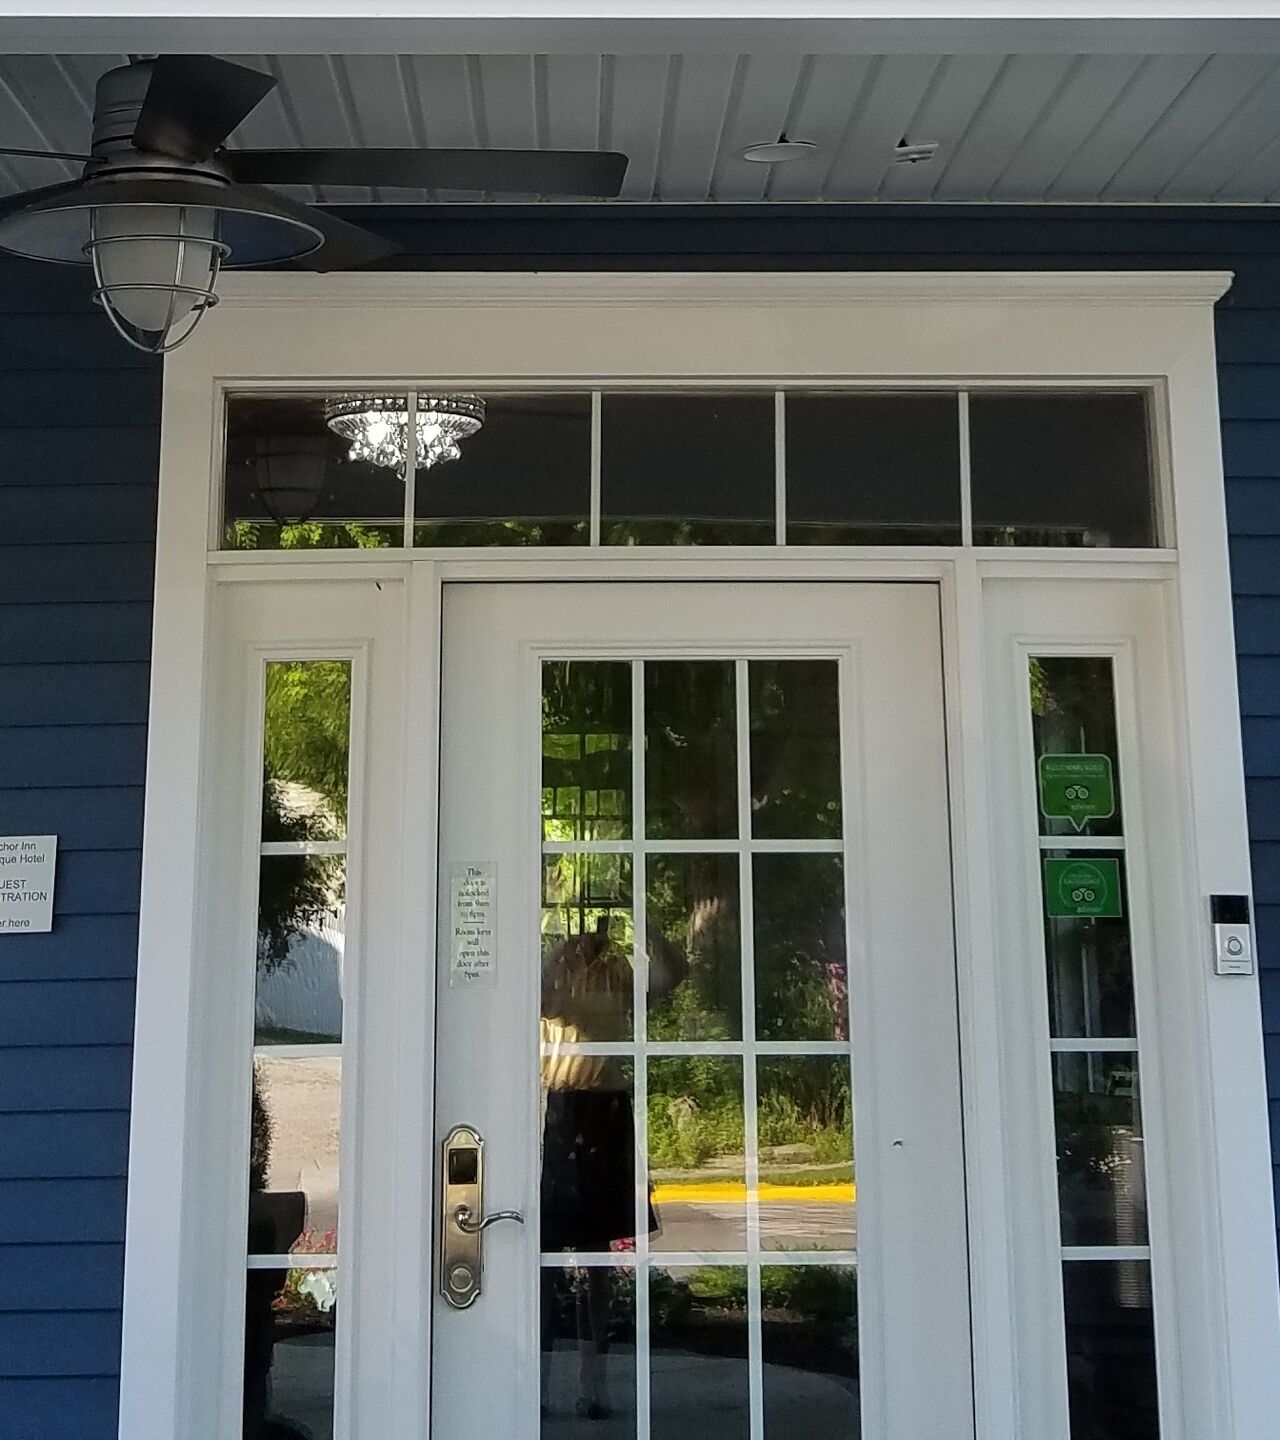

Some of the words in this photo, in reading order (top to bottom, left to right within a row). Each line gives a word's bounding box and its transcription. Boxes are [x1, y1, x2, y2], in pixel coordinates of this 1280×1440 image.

[21, 842, 36, 851] Inn
[19, 854, 45, 863] Hotel
[8, 918, 30, 928] here
